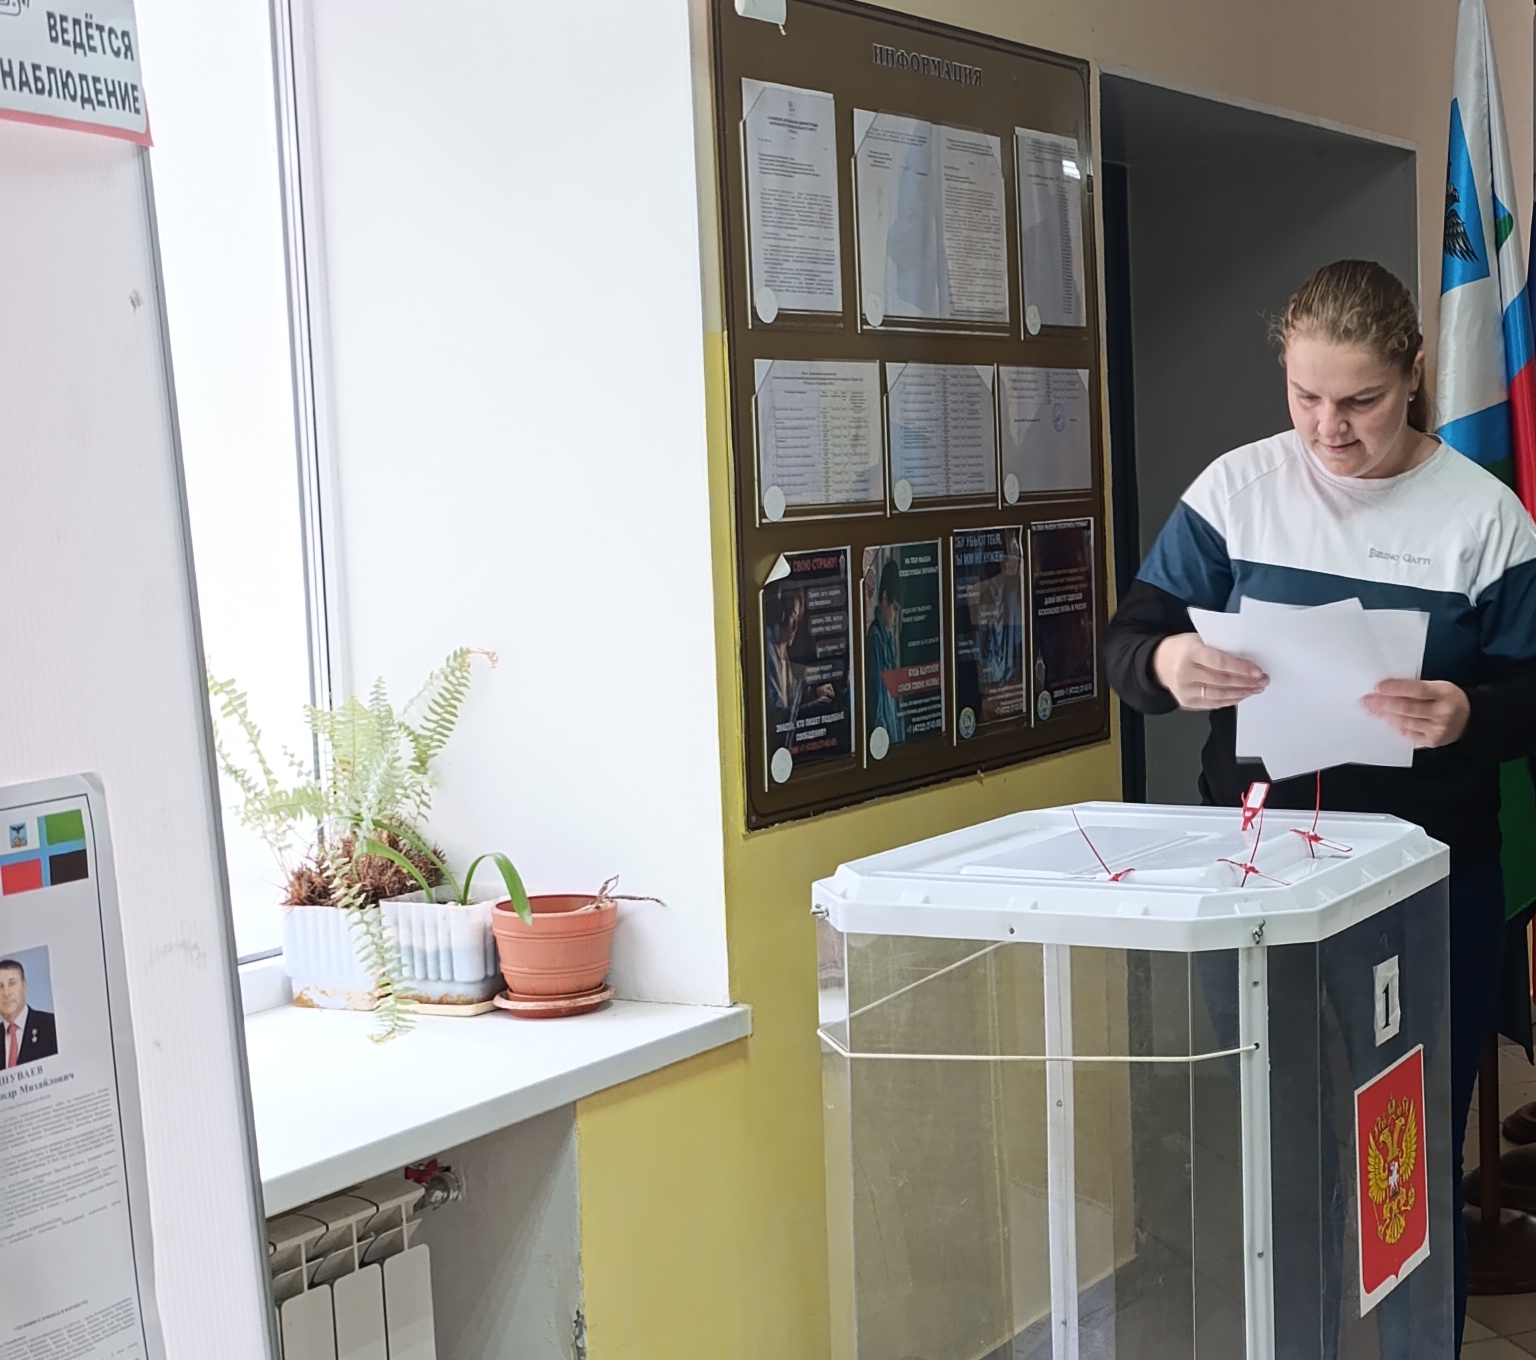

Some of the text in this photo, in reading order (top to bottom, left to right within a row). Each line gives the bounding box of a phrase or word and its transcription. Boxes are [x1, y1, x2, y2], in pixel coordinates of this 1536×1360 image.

[46, 10, 135, 62] ВЕДЁТСЯ
[873, 43, 984, 87] ИНФОРМАЦИЯ
[1380, 983, 1392, 1031] 1
[0, 1065, 43, 1087] ШУВАЕВ
[19, 1073, 75, 1094] Михайлович
